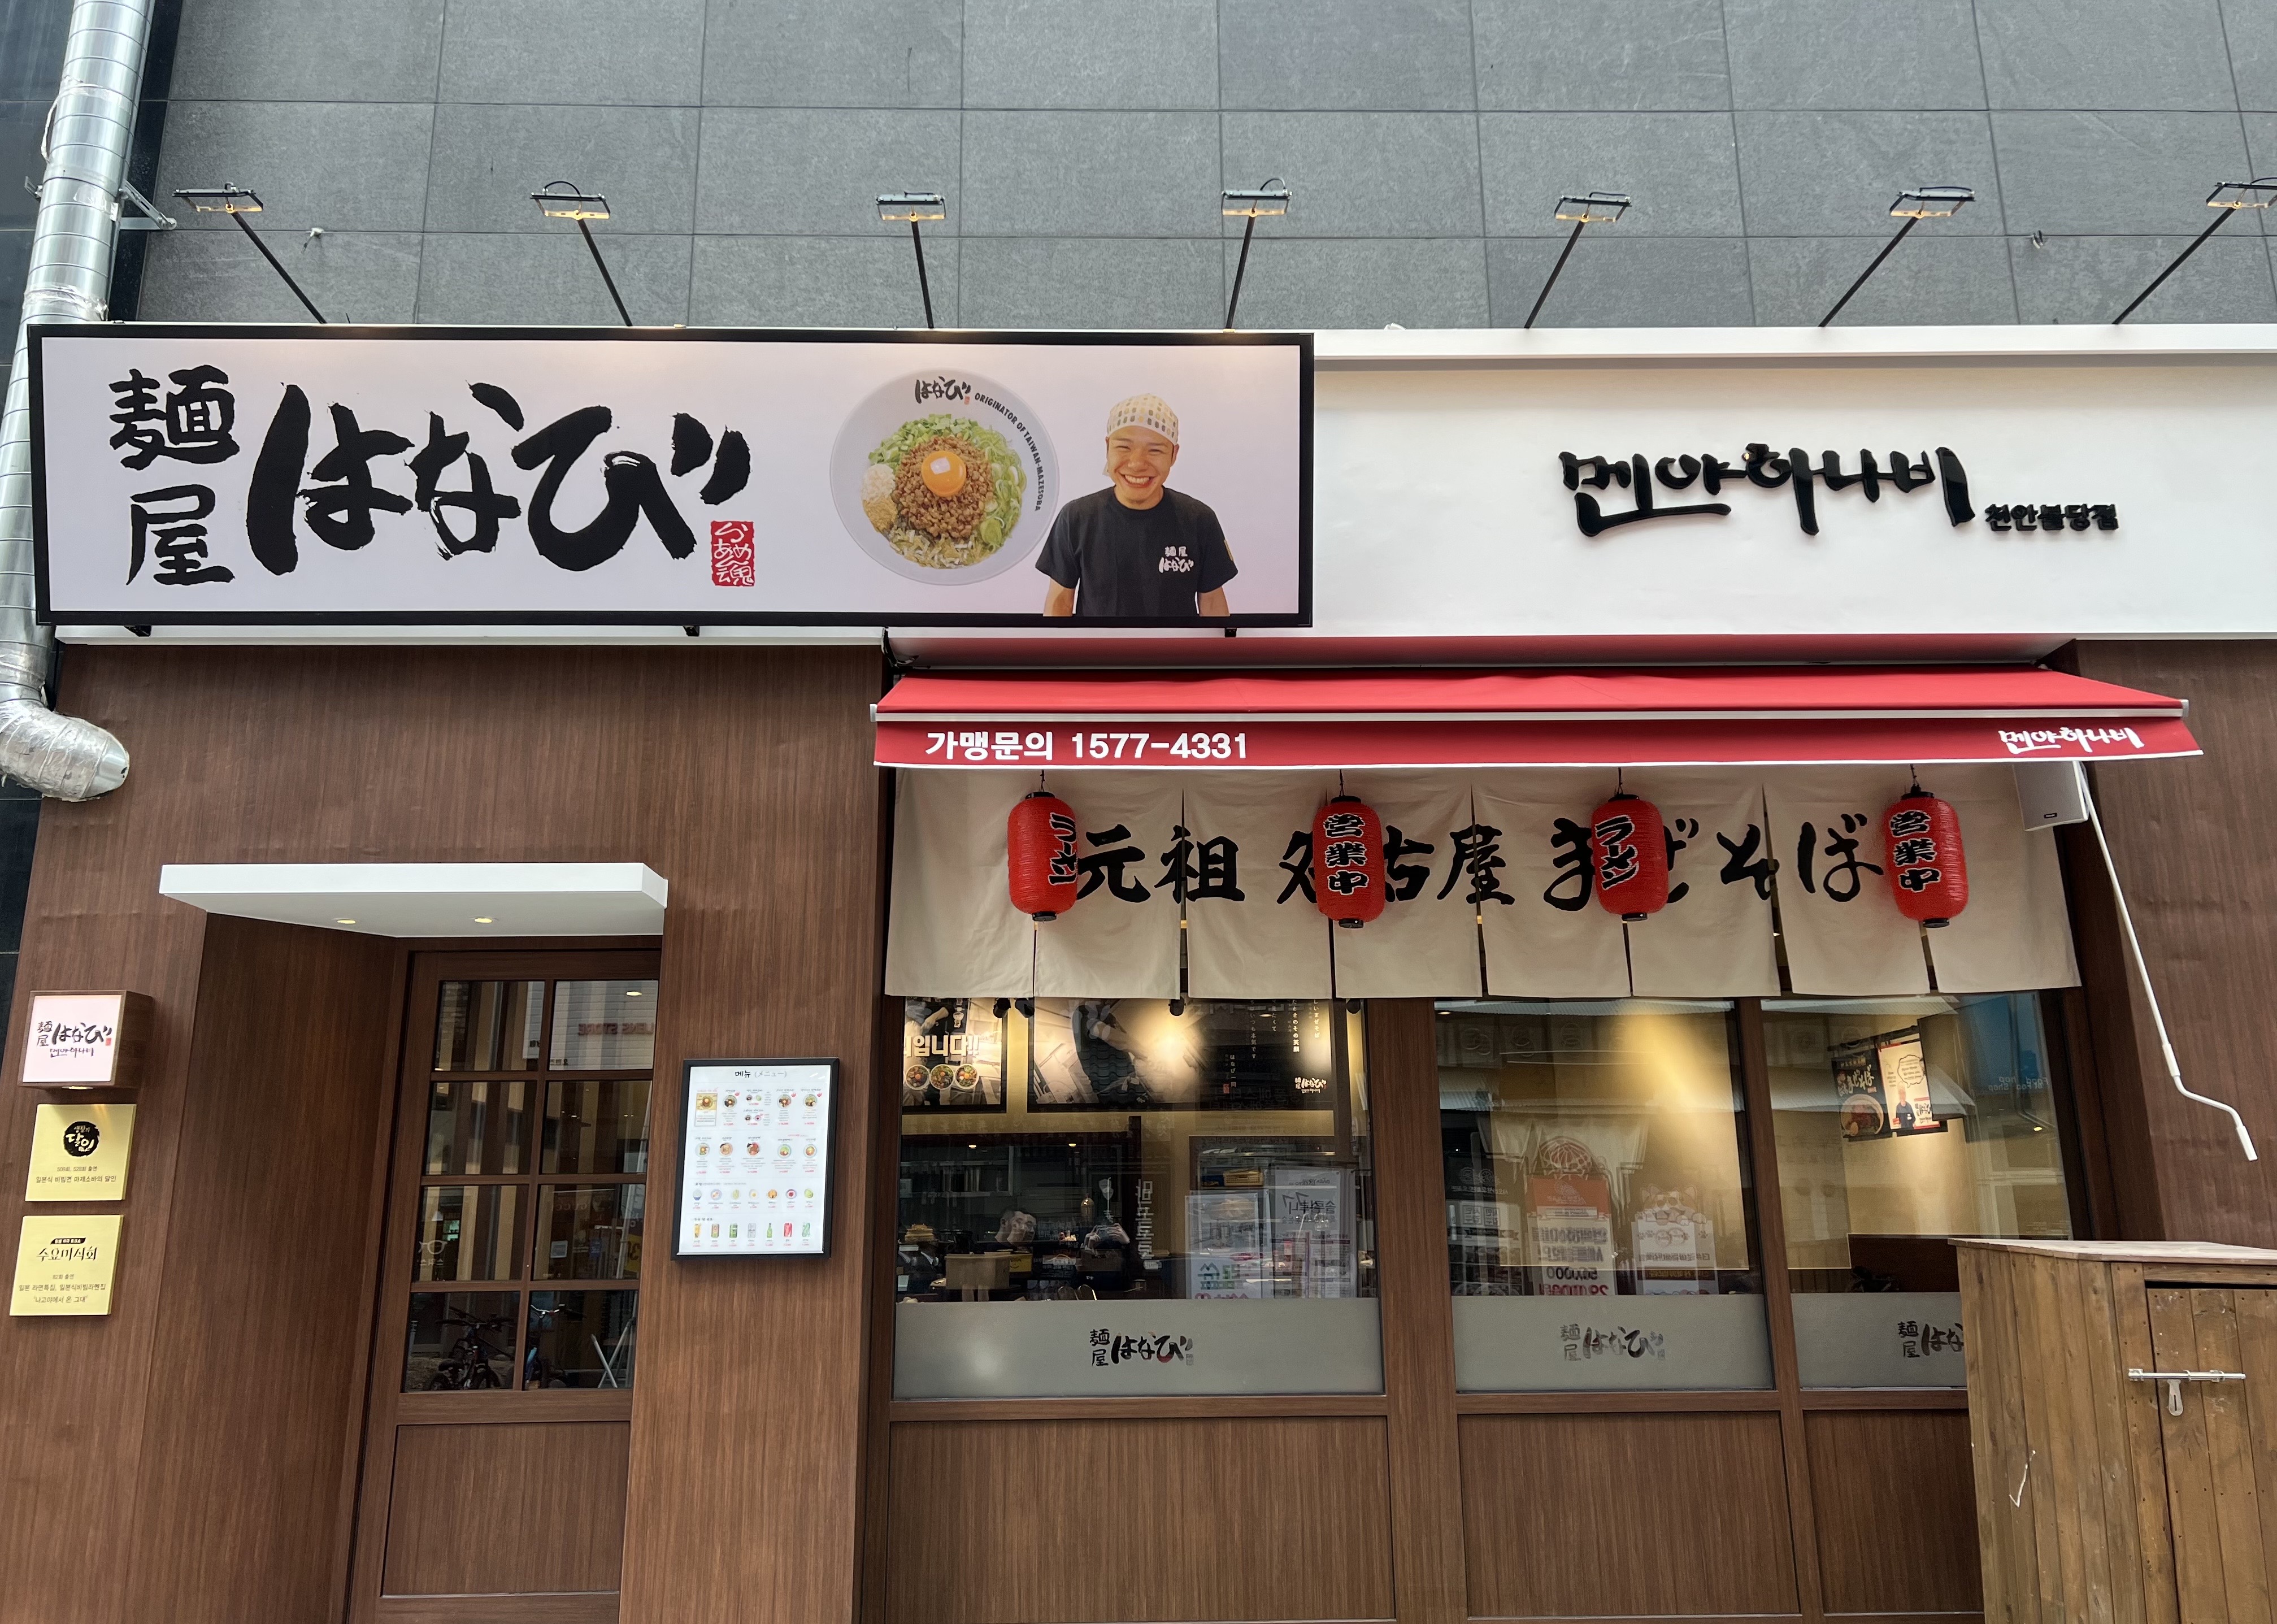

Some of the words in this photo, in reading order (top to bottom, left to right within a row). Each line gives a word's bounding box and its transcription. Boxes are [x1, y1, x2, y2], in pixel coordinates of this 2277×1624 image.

[915, 376, 971, 404] はなび
[975, 392, 1018, 425] ORIGINATOR
[1016, 422, 1026, 433] OF
[1023, 431, 1045, 512] TAIWAN-MAZESOBA
[246, 380, 750, 575] はなび
[1558, 443, 1976, 536] 멘야하나비
[1985, 503, 2120, 531] 천안불당점
[925, 730, 1053, 761] 가맹문의
[1071, 732, 1247, 759] 1577-4331
[1998, 727, 2145, 755] 멘야하나비
[1323, 813, 1370, 896] 営業中
[1889, 809, 1943, 893] 営業中
[51, 1022, 112, 1045] はなび
[735, 1070, 751, 1078] 메뉴
[66, 1132, 94, 1152] 달인
[36, 1246, 98, 1262] 수요미식회
[1111, 1330, 1194, 1365] はなび
